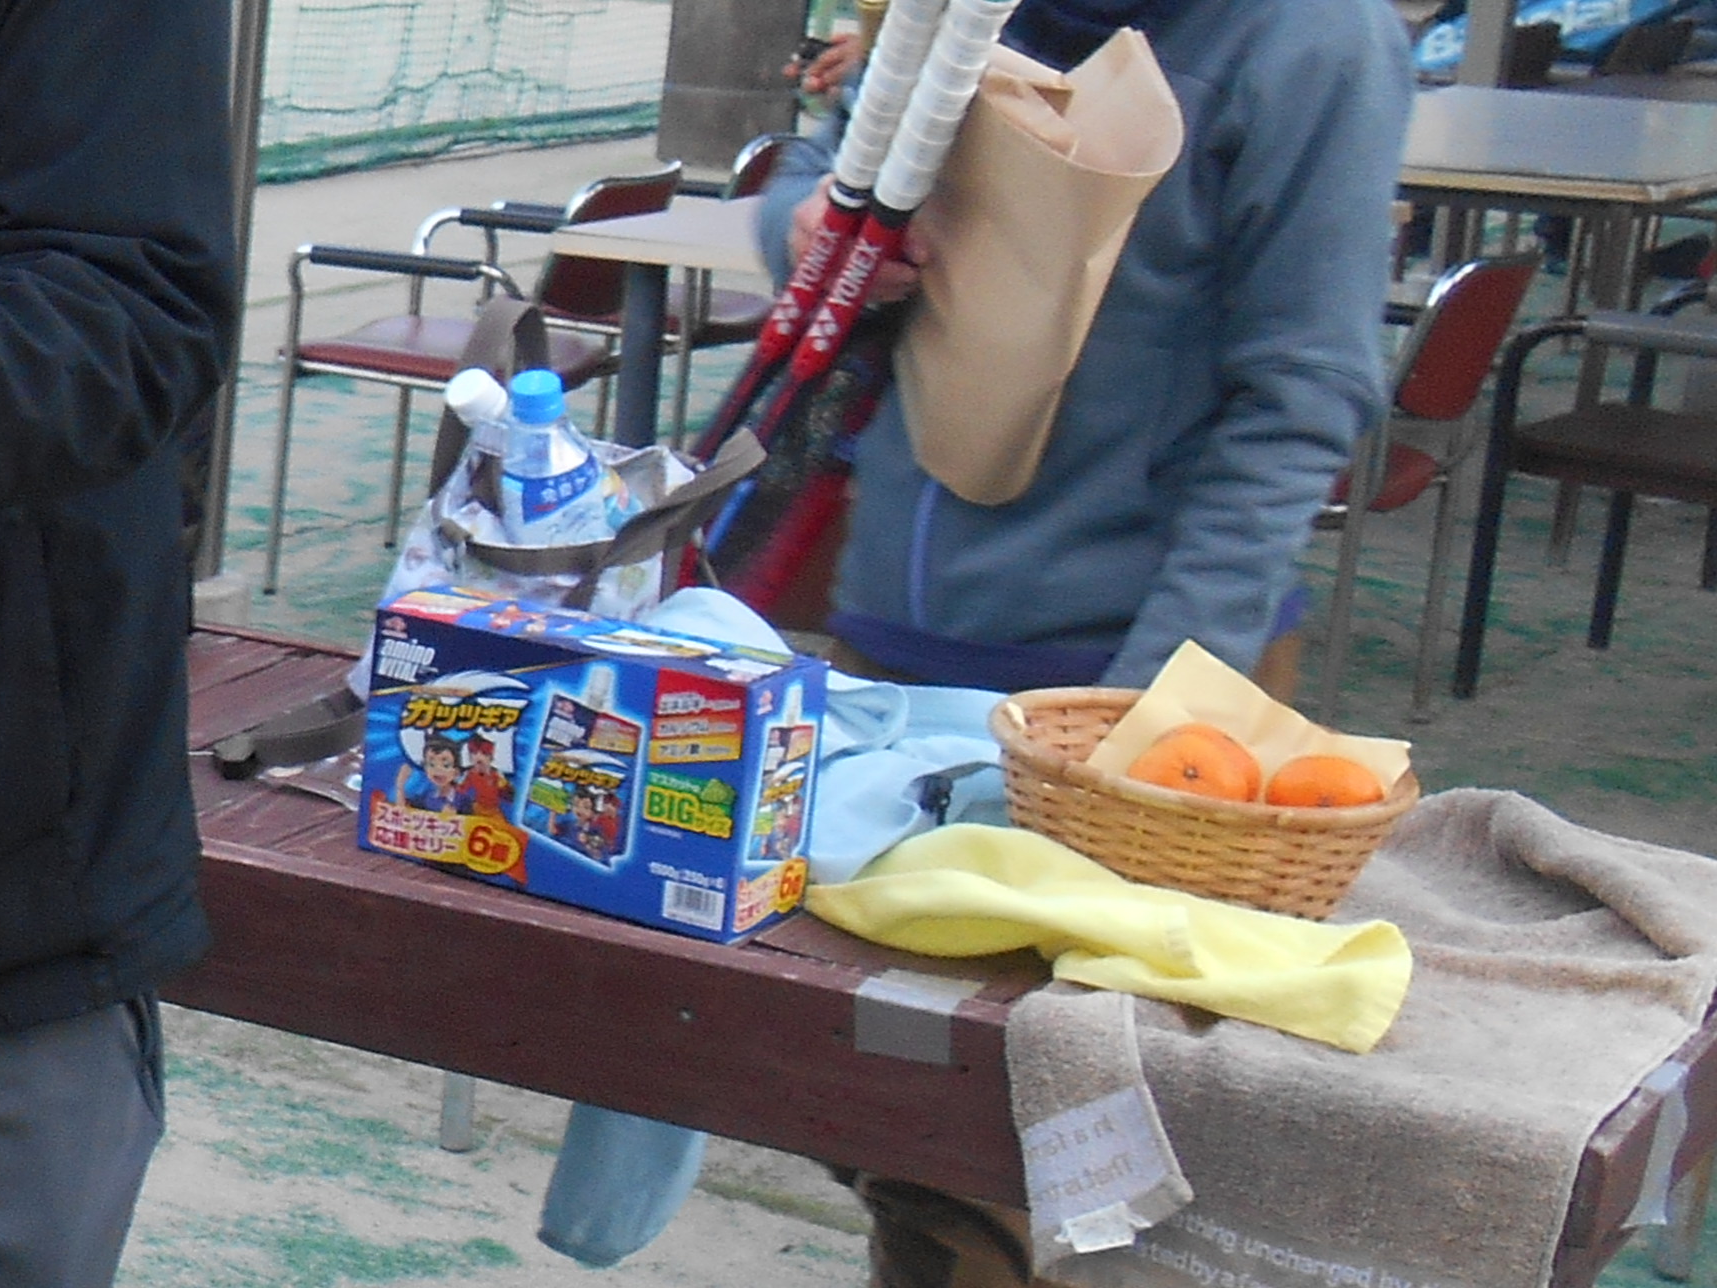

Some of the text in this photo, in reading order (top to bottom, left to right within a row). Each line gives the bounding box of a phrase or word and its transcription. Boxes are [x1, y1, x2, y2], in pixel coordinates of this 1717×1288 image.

[789, 228, 839, 291] YONEX
[828, 238, 882, 306] YONEX
[380, 638, 436, 665] amino
[402, 698, 521, 730] ガッツギア
[647, 788, 698, 826] BIG
[1189, 1252, 1220, 1286] by
[1220, 1270, 1235, 1288] a
[1243, 1237, 1374, 1288] unchanged
